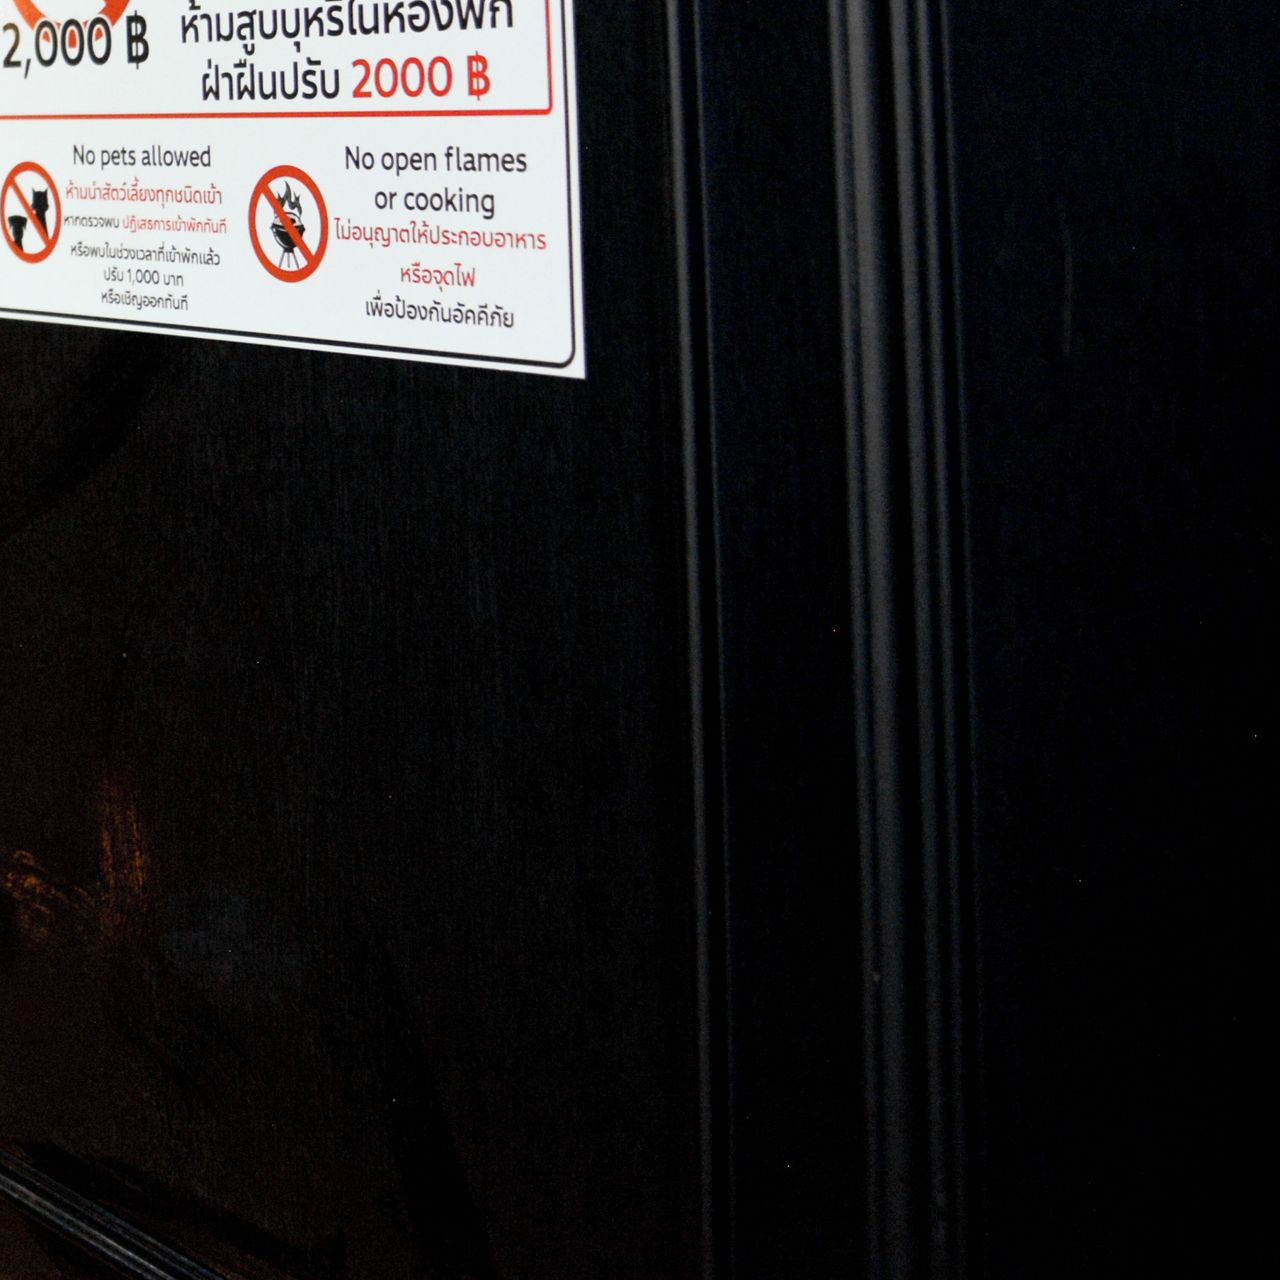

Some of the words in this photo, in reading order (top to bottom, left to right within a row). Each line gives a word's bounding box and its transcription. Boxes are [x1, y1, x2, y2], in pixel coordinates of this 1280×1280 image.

[2, 17, 113, 78] 2,000
[201, 57, 340, 101] ฝ่าฝืนปรับ
[351, 56, 454, 99] 2000
[73, 145, 96, 166] No
[100, 147, 137, 171] pets
[141, 145, 211, 167] allowed
[344, 146, 375, 171] No
[381, 151, 437, 176] open
[444, 146, 528, 173] flames
[374, 190, 398, 211] or
[403, 187, 496, 220] cooking
[334, 217, 547, 251] ไม่อนุญาตให้ประกอบอาหาร
[103, 267, 125, 283] ปรับ
[127, 268, 160, 287] 1,000
[163, 273, 185, 288] บาท
[400, 261, 476, 292] หรือจุดไฟ
[365, 288, 516, 328] เพื่อป้องกันอัคคีภัย
